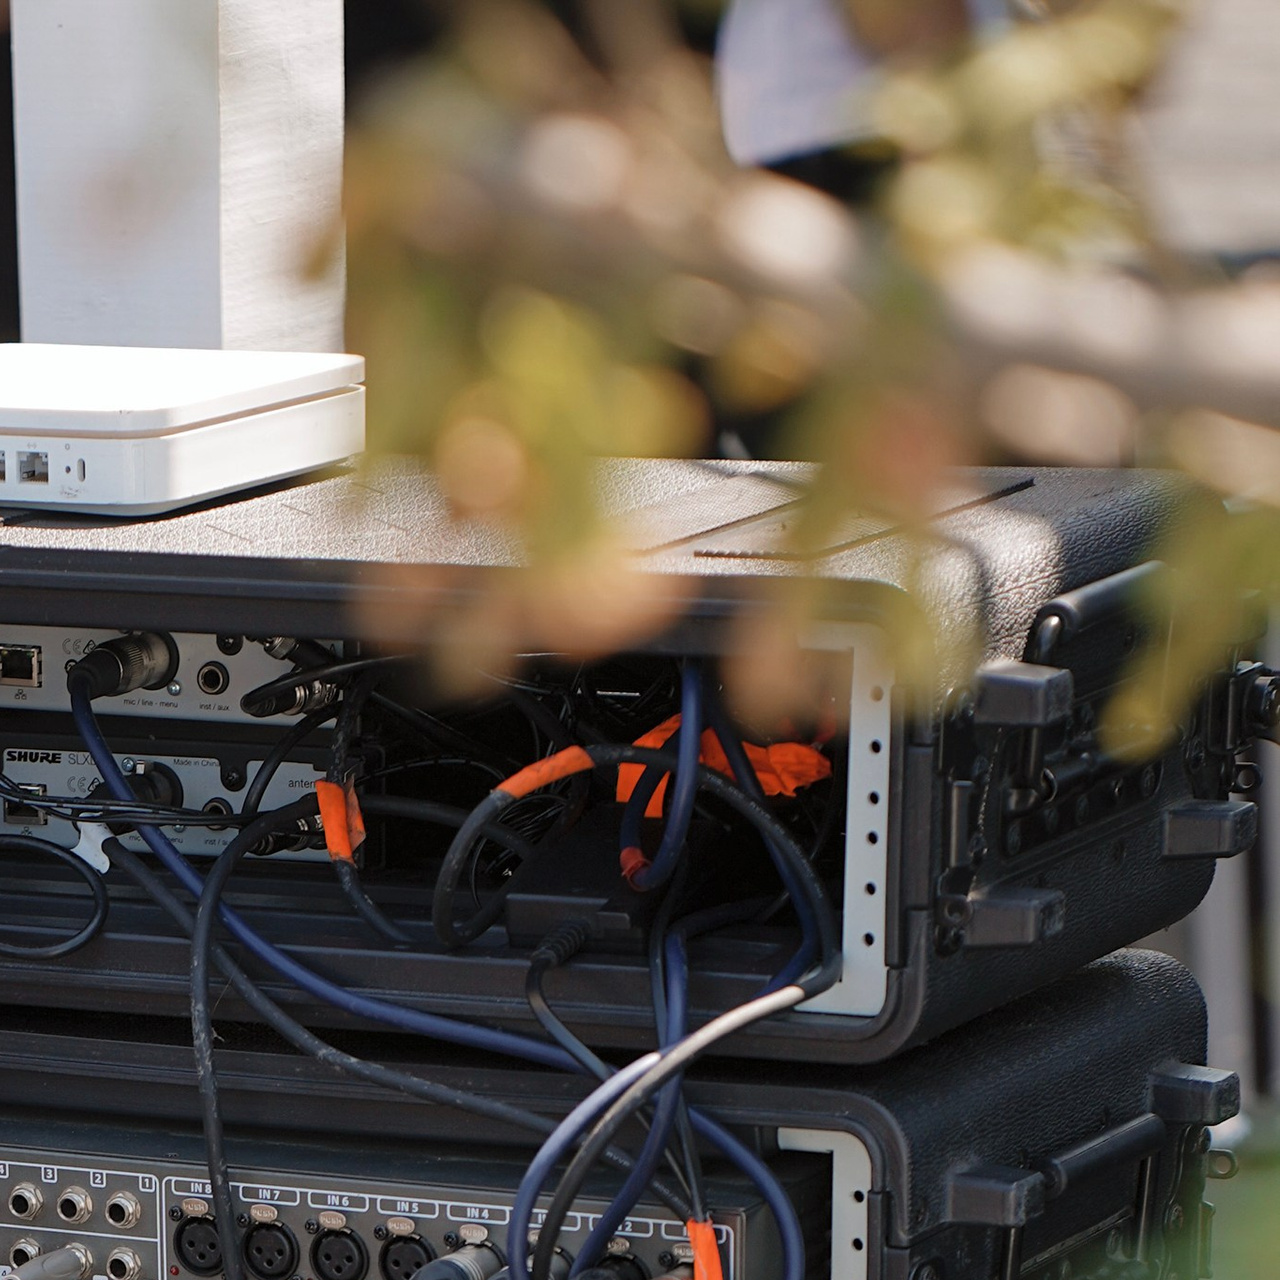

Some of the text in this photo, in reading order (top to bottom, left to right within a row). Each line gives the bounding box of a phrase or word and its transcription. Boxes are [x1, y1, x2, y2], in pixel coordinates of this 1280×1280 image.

[123, 698, 178, 708] mic line menu
[199, 702, 210, 710] inst
[6, 751, 61, 764] SHURE
[173, 758, 191, 767] Made
[200, 758, 221, 768] China
[190, 1183, 202, 1194] IN
[258, 1189, 270, 1200] IN
[327, 1195, 339, 1206] IN
[397, 1201, 409, 1212] IN
[467, 1207, 478, 1218] IN
